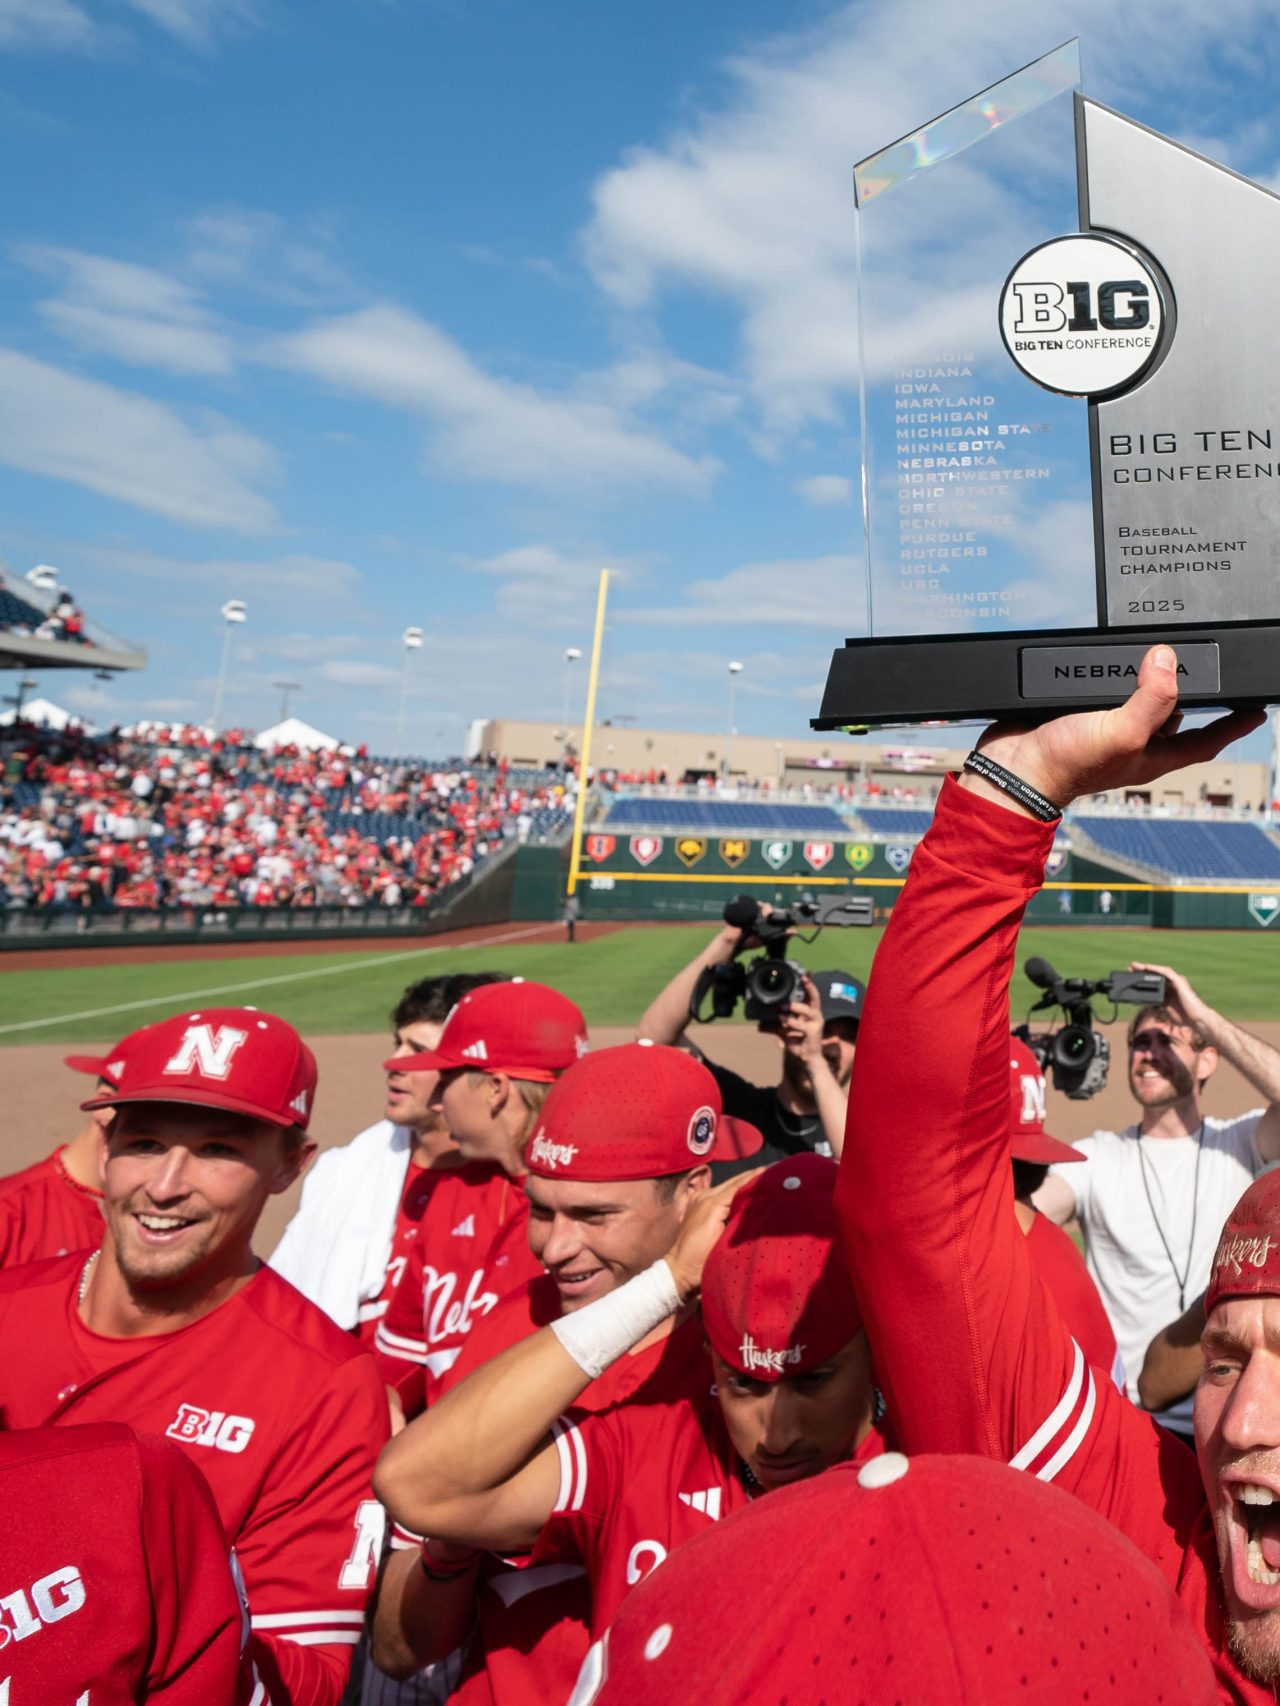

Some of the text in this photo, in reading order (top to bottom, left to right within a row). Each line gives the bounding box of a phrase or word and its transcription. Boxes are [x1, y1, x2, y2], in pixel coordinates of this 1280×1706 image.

[1015, 337, 1152, 351] BIG TEN CONFERENCE
[895, 367, 973, 379] INDIANA
[895, 383, 941, 394] IOWA
[895, 395, 995, 409] MARYLAND
[896, 411, 989, 424] MICHIGAN
[896, 425, 990, 439] MICHIGAN
[897, 440, 1006, 454] MINNESOTA
[1110, 429, 1272, 456] BIG TEN
[897, 456, 997, 469] NEBRASKA
[898, 468, 1051, 484] NORTHWESTERN
[898, 486, 945, 499] OHIO
[900, 518, 950, 530] PENN
[900, 532, 977, 545] PURDUE
[900, 547, 988, 560] RUTGERS
[1120, 541, 1247, 556] TOURNAMENT
[901, 563, 951, 575] UCLA
[1120, 560, 1231, 575] CHAMPIONS
[1128, 600, 1184, 613] 2025
[1054, 663, 1189, 679] NEBRAA
[163, 1023, 248, 1082] N
[1019, 1074, 1047, 1124] N
